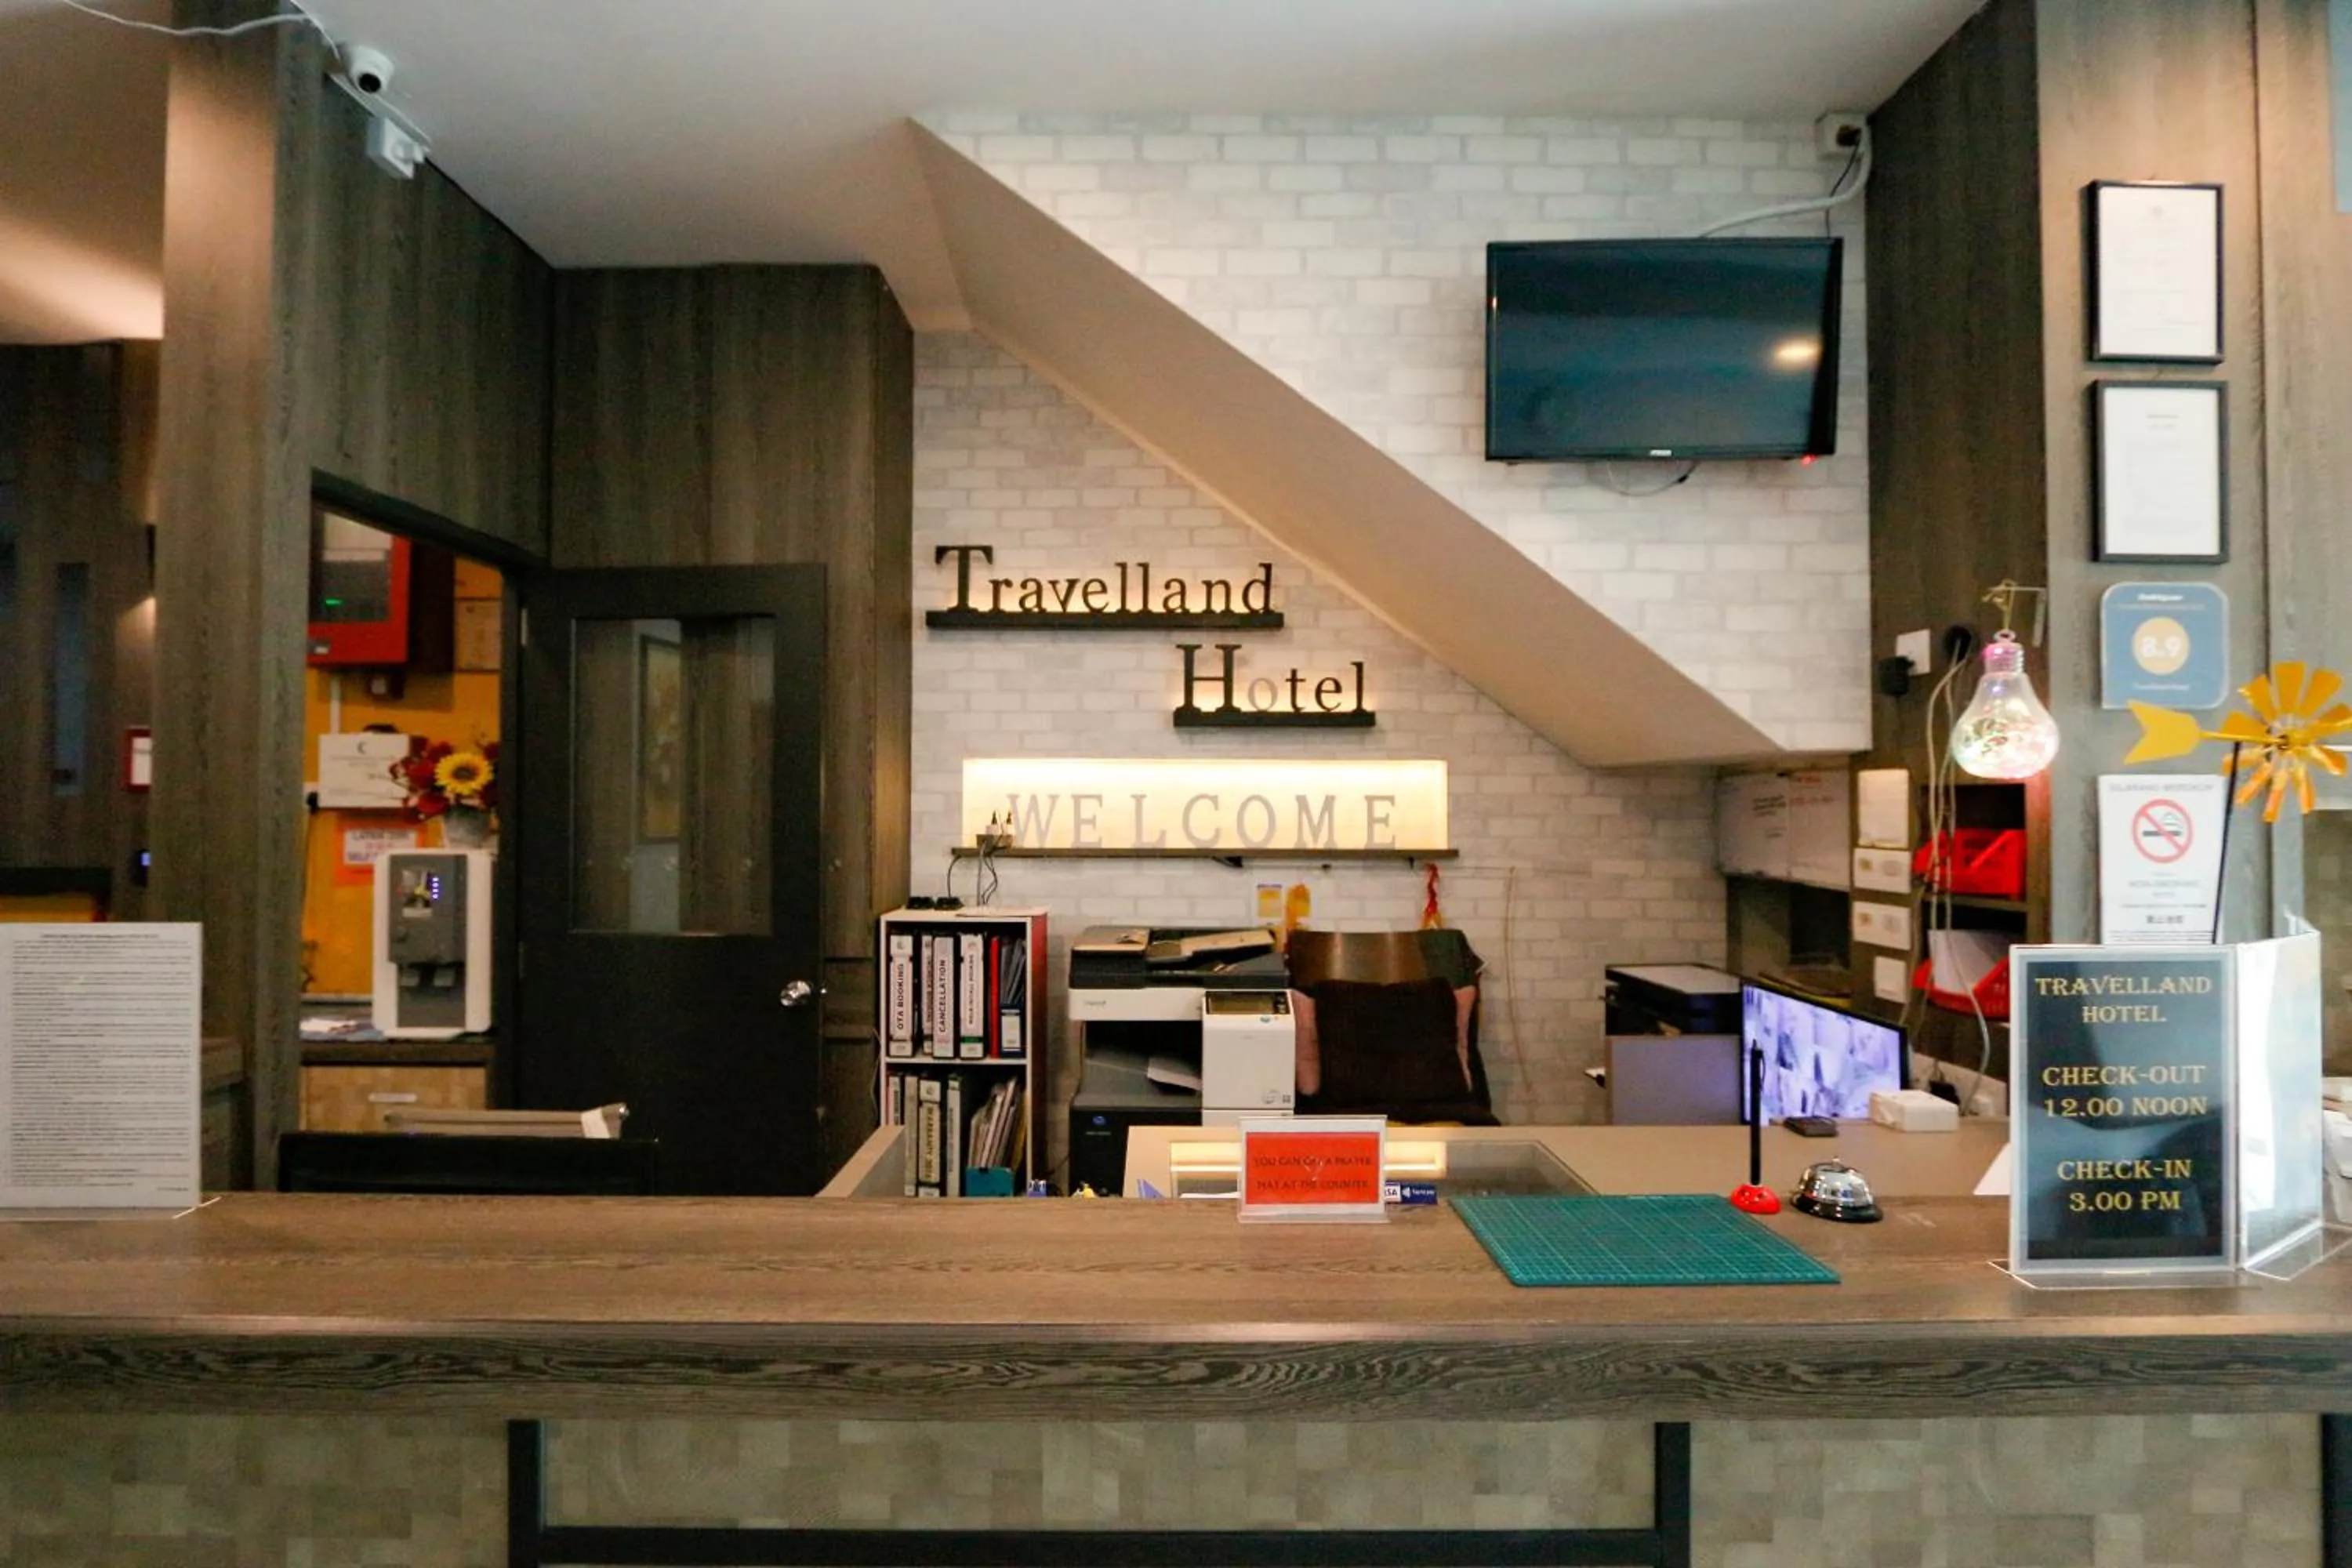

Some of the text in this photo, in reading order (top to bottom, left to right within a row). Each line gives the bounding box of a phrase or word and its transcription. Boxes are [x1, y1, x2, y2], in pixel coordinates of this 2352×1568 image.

[935, 545, 1273, 613] Travelland
[1175, 643, 1367, 712] Hotel
[1008, 793, 1396, 849] WELCOME
[2035, 976, 2212, 995] TRAVELLAND
[2082, 1006, 2167, 1023] HOTEL
[2042, 1065, 2205, 1086] CHECK-OUT
[2045, 1097, 2207, 1117] 12.00 NOON
[1254, 1156, 1276, 1167] YOU
[1279, 1156, 1300, 1166] CAN
[2056, 1159, 2191, 1181] CHECK-IN
[2069, 1191, 2180, 1212] 3.00 PM
